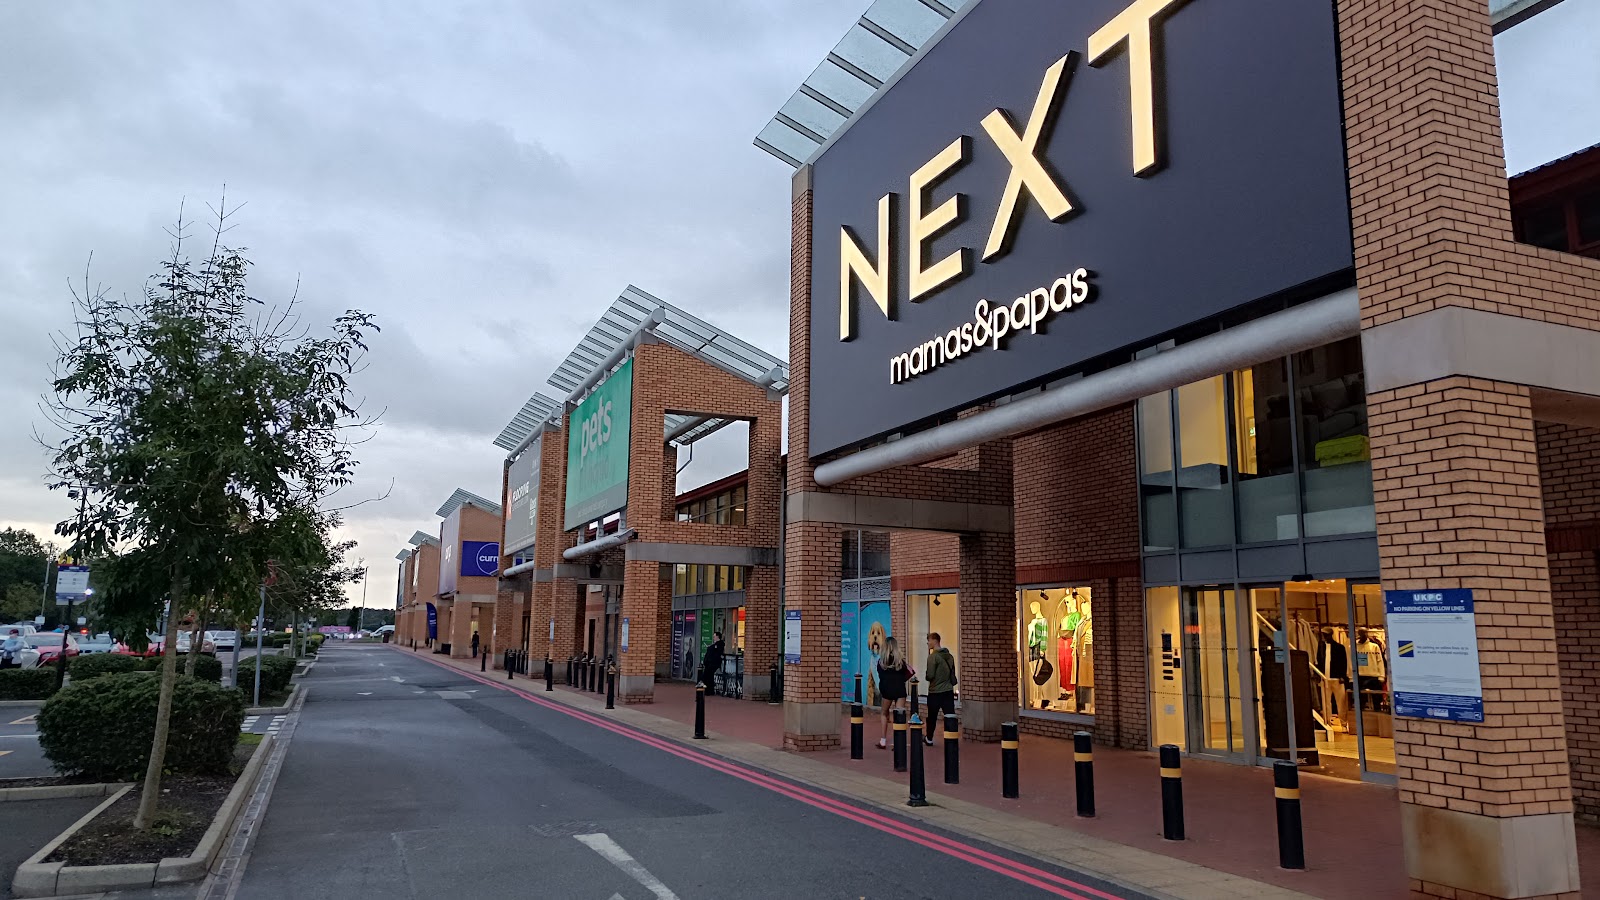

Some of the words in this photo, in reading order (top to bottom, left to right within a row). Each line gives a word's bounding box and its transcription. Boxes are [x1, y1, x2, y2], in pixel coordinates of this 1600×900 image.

[839, 0, 1186, 342] NEXT
[890, 267, 1089, 385] mamas&papas
[580, 394, 612, 470] pets
[1413, 593, 1443, 602] UKPC
